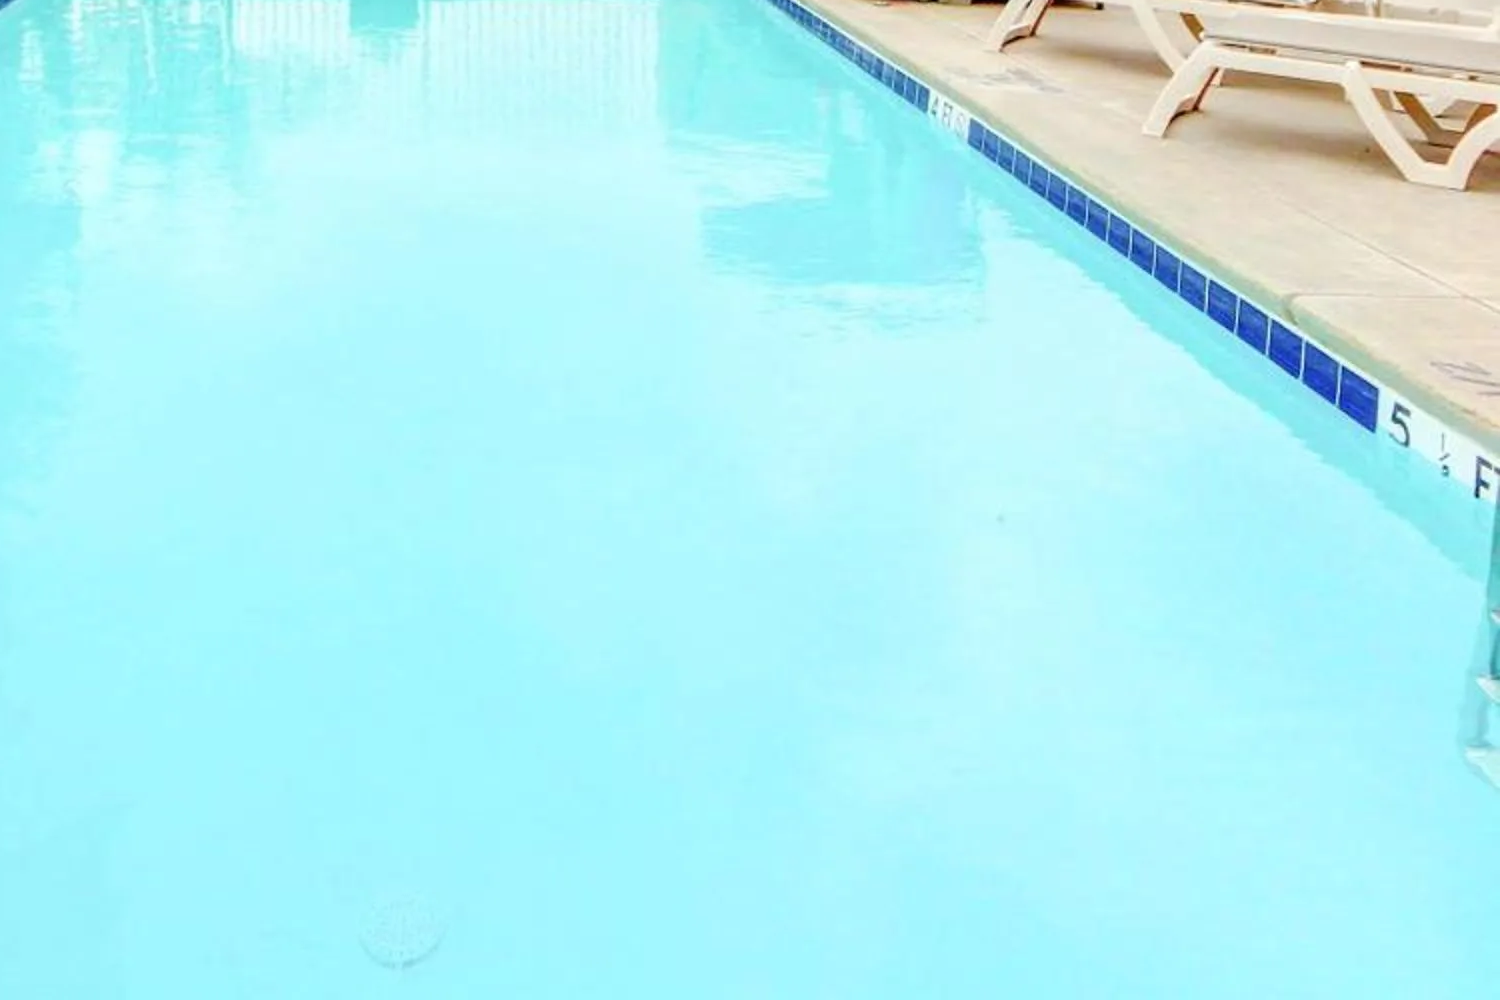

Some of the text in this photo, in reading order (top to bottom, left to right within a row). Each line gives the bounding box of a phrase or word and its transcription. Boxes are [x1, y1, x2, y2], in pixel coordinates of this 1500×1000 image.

[942, 101, 954, 129] FT
[1388, 402, 1411, 448] 5
[1473, 455, 1500, 499] F
